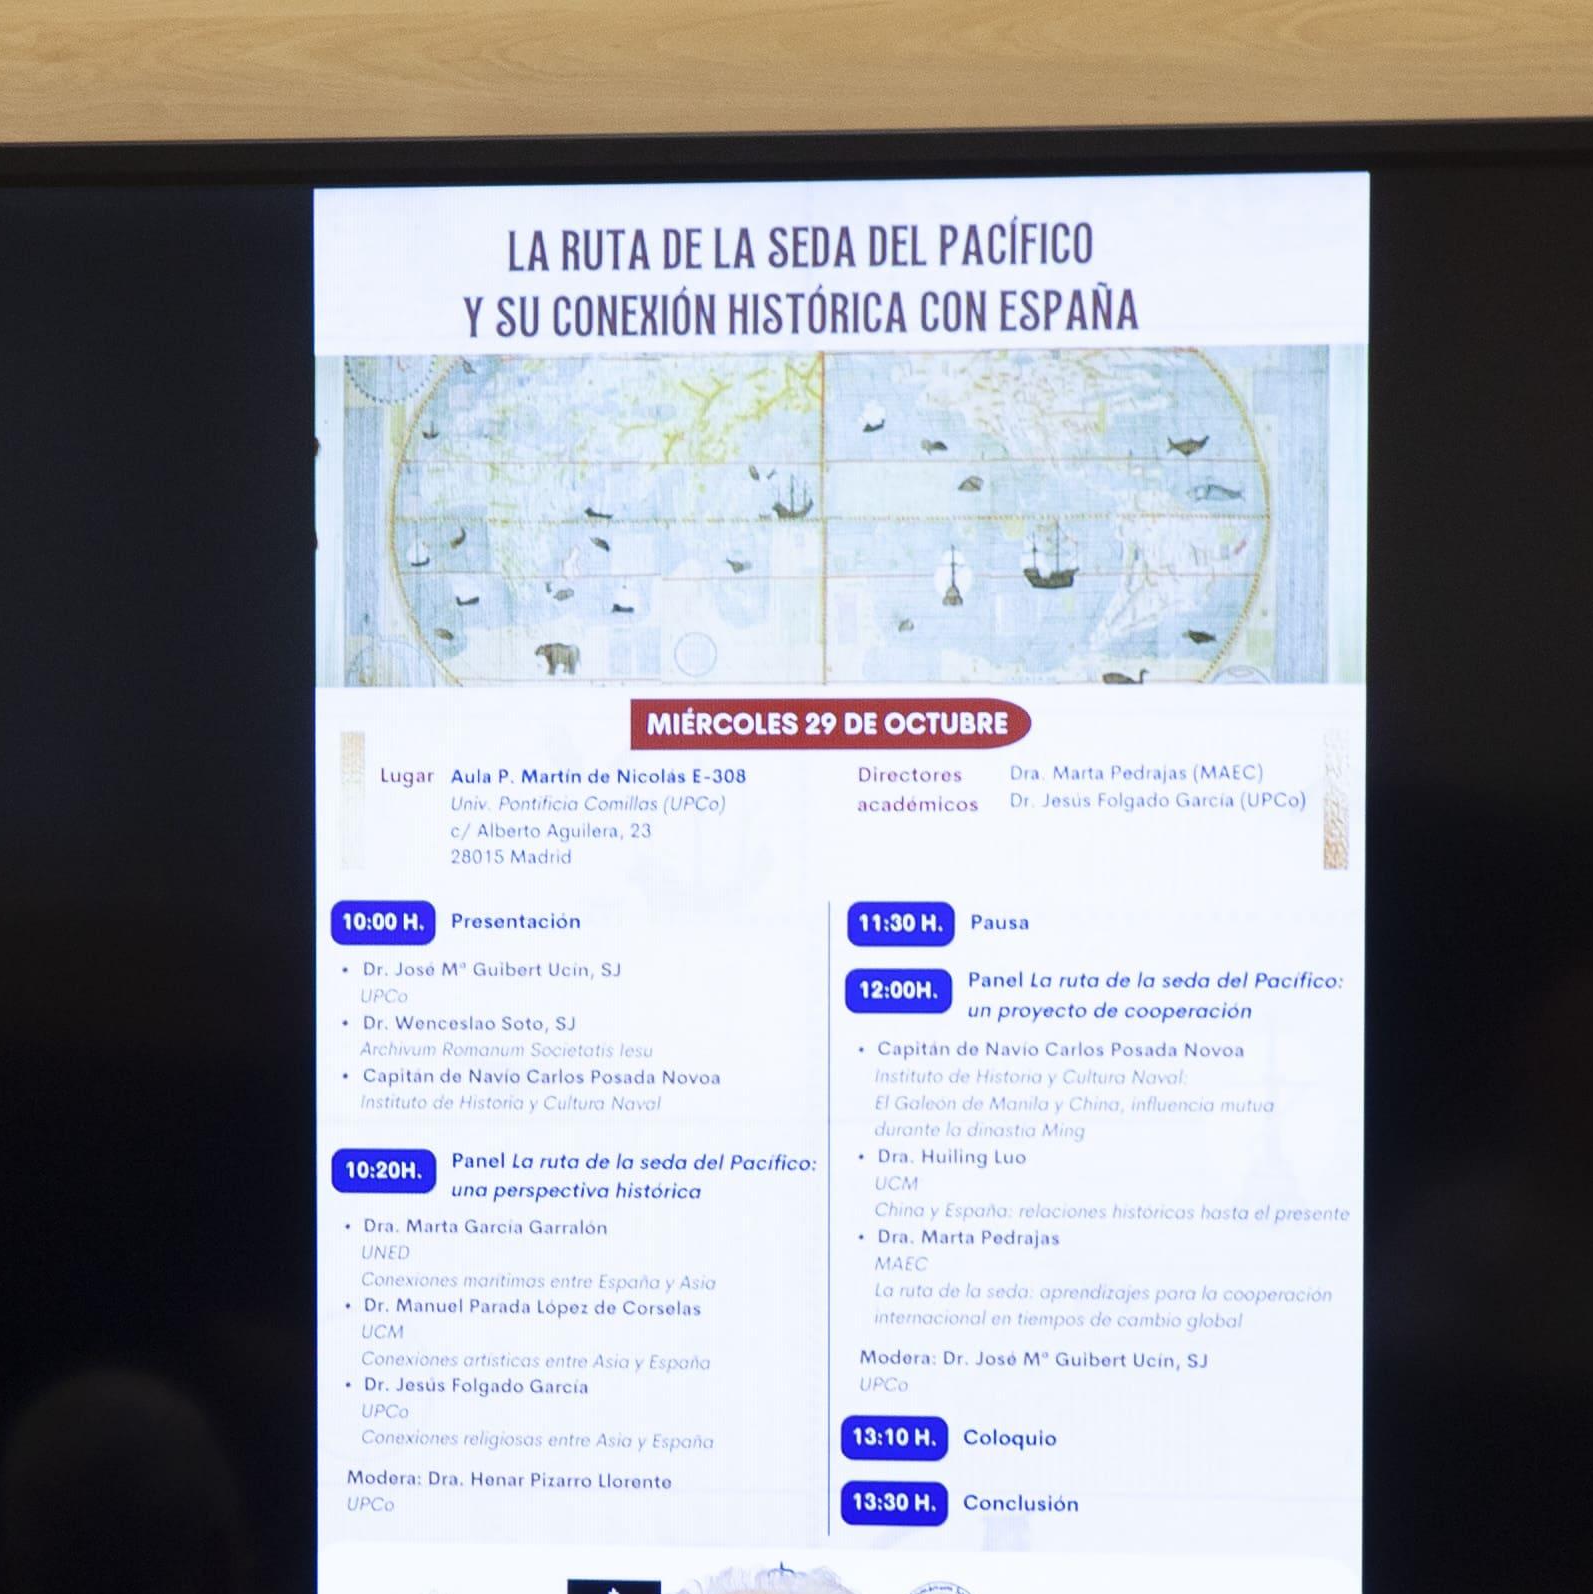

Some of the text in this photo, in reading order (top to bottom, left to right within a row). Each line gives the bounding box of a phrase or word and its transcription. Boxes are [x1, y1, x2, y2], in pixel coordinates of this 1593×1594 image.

[508, 215, 1094, 273] LA RUTA DE LA SEDA DEL PACÍFICO
[463, 281, 1139, 339] Y SU CONEXIÓN HISTÓRICA CON ESPAÑA
[647, 707, 1009, 737] MIÉRCOLES 29 DE OCTUBRE
[380, 766, 435, 789] Lugar
[450, 767, 747, 785] Aula P. Martín de Nicolás E-308
[858, 766, 962, 783] Directores
[1010, 763, 1264, 784] Dra. Marta Pedrajas (MAEC)
[450, 794, 726, 816] Univ. Pontificia Comillas (UPCo)
[857, 795, 979, 813] académicos
[1009, 791, 1034, 809] Dr.
[1097, 791, 1170, 813] Folgado
[1239, 791, 1307, 813] (UPCo)
[450, 822, 652, 844] c/ Alberto Aguilera, 23
[450, 848, 572, 866] 28015 Madrid
[342, 911, 581, 932] 10:00 H. Presentación
[858, 912, 1030, 933] 11:30 H. Pausa
[363, 960, 389, 977] Dr.
[394, 961, 436, 977] José
[472, 960, 542, 977] Guibert
[600, 961, 621, 978] SJ
[968, 970, 1343, 989] Panel La ruta de la seda del Pacífico:
[360, 987, 409, 1004] UPCo
[859, 979, 938, 1000] 12:00H.
[967, 1001, 1253, 1024] un proyecto de cooperación
[363, 1014, 576, 1035] Dr. Wenceslao Soto, SJ
[877, 1040, 1245, 1062] Capitán de Navío Carlos Posada Novoa
[363, 1067, 721, 1089] Capitán de Navío Carlos Posada Novoa
[452, 1151, 817, 1172] Panel La ruta de la seda del Pacífico:
[878, 1147, 1027, 1170] Dra. Huiling Luo
[345, 1160, 423, 1180] 10:20H.
[451, 1181, 702, 1204] una perspectiva histórica
[874, 1174, 919, 1192] UCM
[363, 1217, 608, 1236] Dra. Marta García Garralón
[878, 1228, 1060, 1250] Dra. Marta Pedrajas
[361, 1244, 411, 1261] UNED
[874, 1255, 929, 1272] MAEC
[364, 1296, 702, 1320] Dr. Manuel Parada López de Corselas
[361, 1323, 405, 1340] UCM
[859, 1348, 936, 1366] Modera:
[943, 1350, 969, 1366] Dr.
[975, 1350, 1018, 1367] José
[1055, 1351, 1127, 1368] Guibert
[1186, 1353, 1208, 1369] SJ
[364, 1376, 589, 1398] Dr. Jesús Folgado García
[859, 1376, 909, 1393] UPCo
[361, 1402, 410, 1420] UPCo
[853, 1426, 1058, 1452] 13:10 H. Coloquio
[347, 1468, 672, 1490] Modera: Dra. Henar Pizarro Llorente
[346, 1496, 395, 1513] UPCo
[852, 1491, 1079, 1513] 13:30 H. Conclusión
